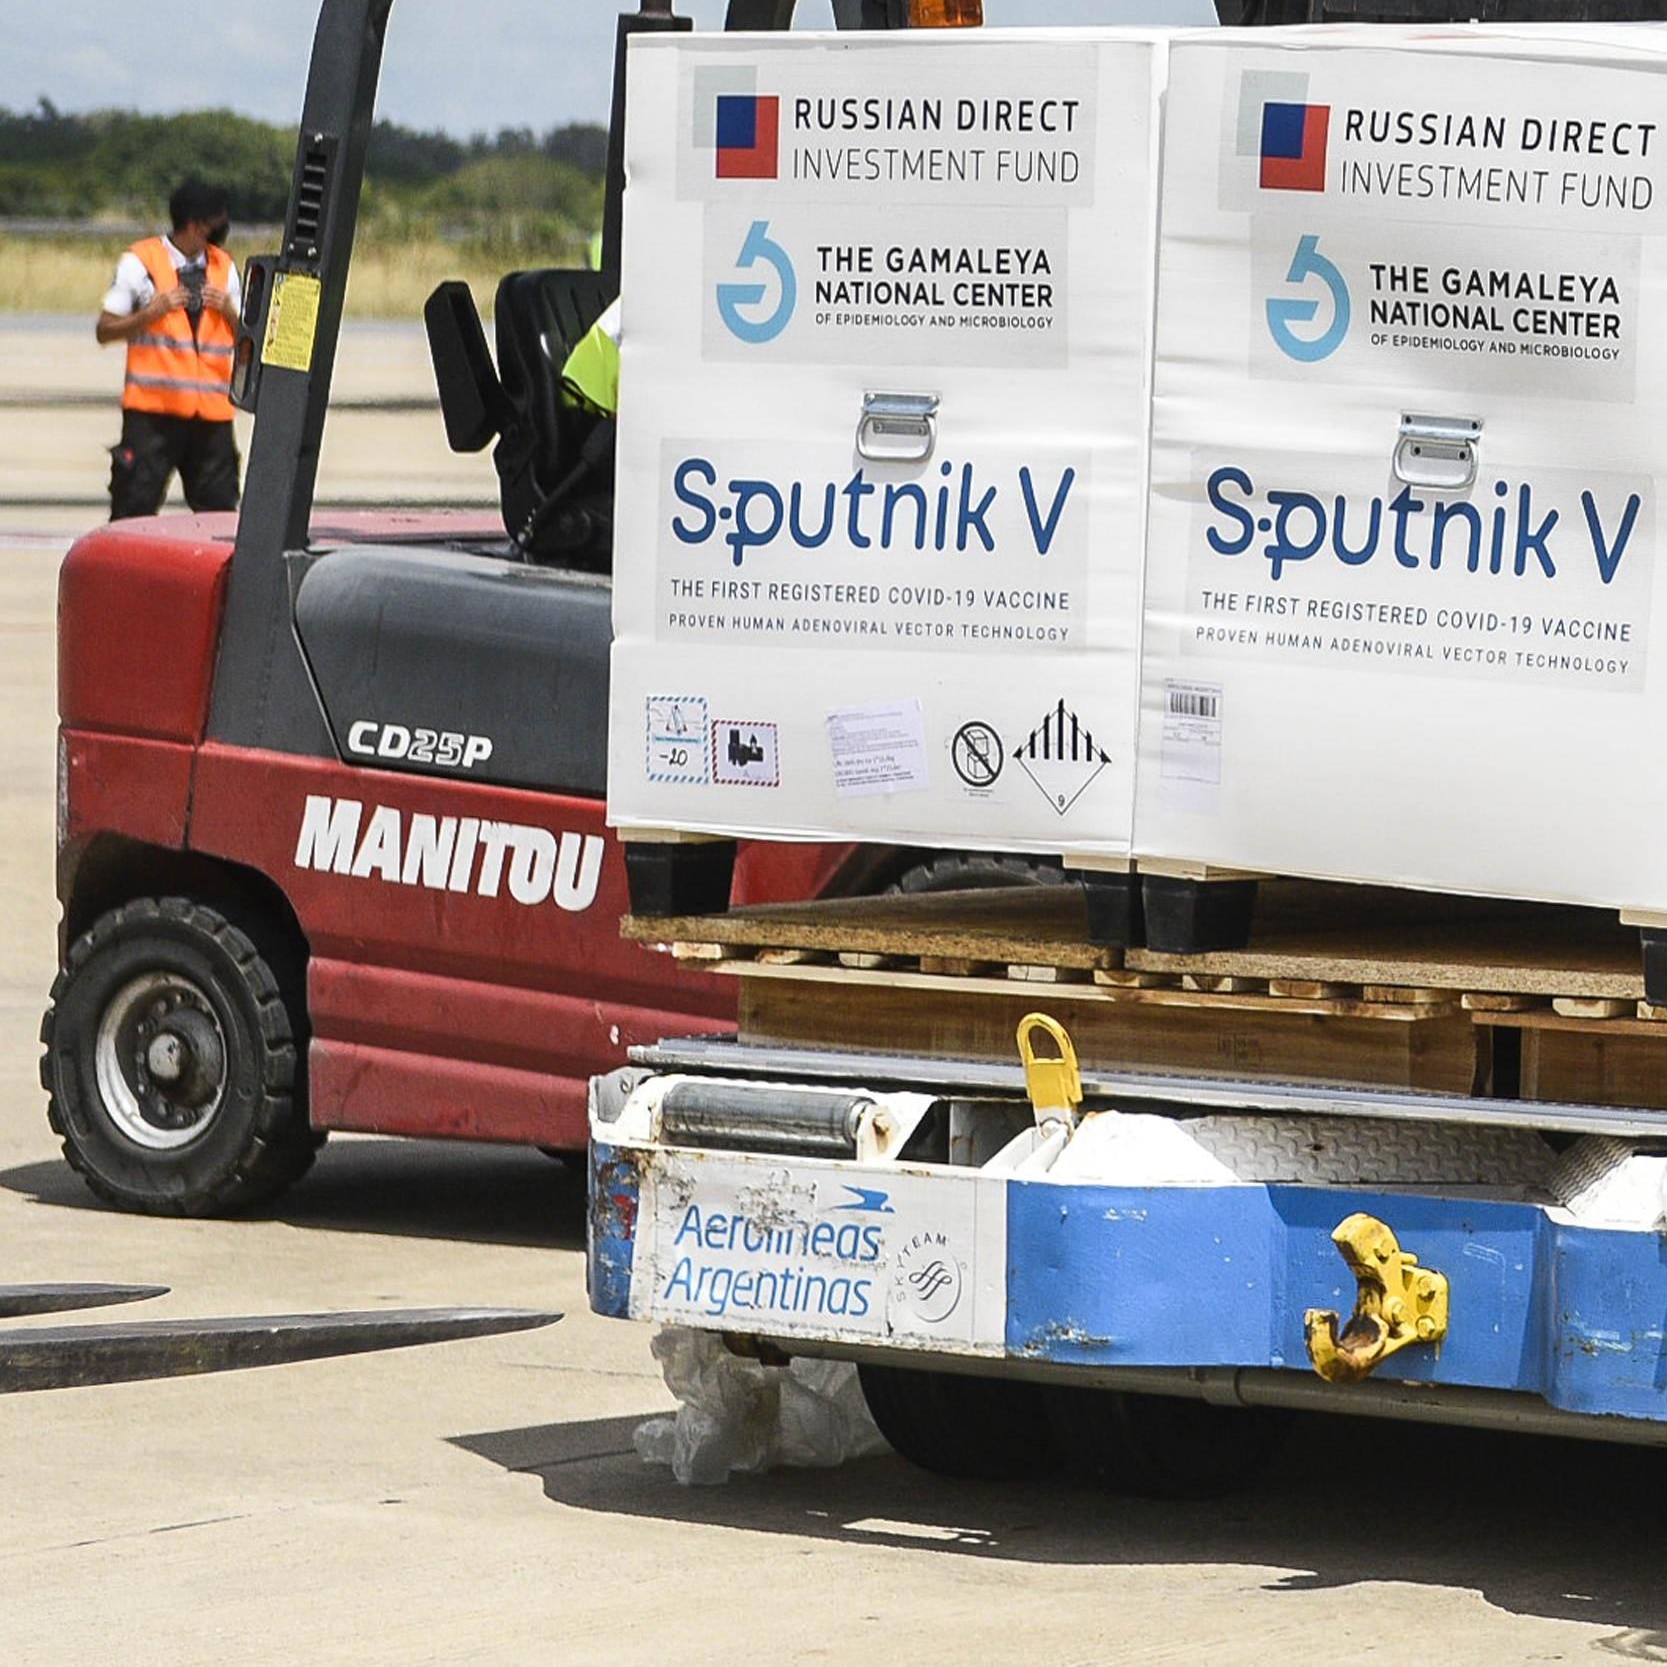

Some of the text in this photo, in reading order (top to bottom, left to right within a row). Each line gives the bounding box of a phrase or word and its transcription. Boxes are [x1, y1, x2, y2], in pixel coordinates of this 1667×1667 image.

[795, 99, 1079, 132] RUSSIAN DIRECT
[1345, 110, 1656, 156] RUSSIAN DIRECT
[793, 149, 1079, 182] INVESTMENT FUND
[1341, 161, 1652, 210] INVESTMENT FUND
[816, 247, 1051, 274] THE GAMALEYA
[815, 281, 1052, 307] NATIONAL CENTER
[1369, 264, 1619, 304] THE GAMALEYA
[815, 313, 1053, 331] OF EPIDEMIOLOGY AND MICROBIOLOGY
[1370, 300, 1620, 339] NATIONAL CENTER
[1369, 331, 1619, 363] OF EPIDEMIOLOGY AND MICROBIOLOGY
[672, 458, 1075, 566] Sputnik V
[1206, 467, 1640, 584] Sputnik V
[670, 579, 1069, 610] THE FIRST REGISTERED COVID-19 VACCINE
[669, 610, 1068, 642] PROVEN HUMAN ADENOVIRAL VECTOR TECHNOLOGY
[1201, 591, 1631, 642] THE FIRST REGISTERED COVID-19 VACCINE
[1195, 626, 1628, 673] PROVEN HUMAN ADENOVIRAL VECTOR TECHNOLOGY
[348, 720, 493, 768] CD25P
[1058, 795, 1066, 807] 9
[294, 794, 604, 912] MANITOU
[664, 1256, 872, 1316] Argentinas
